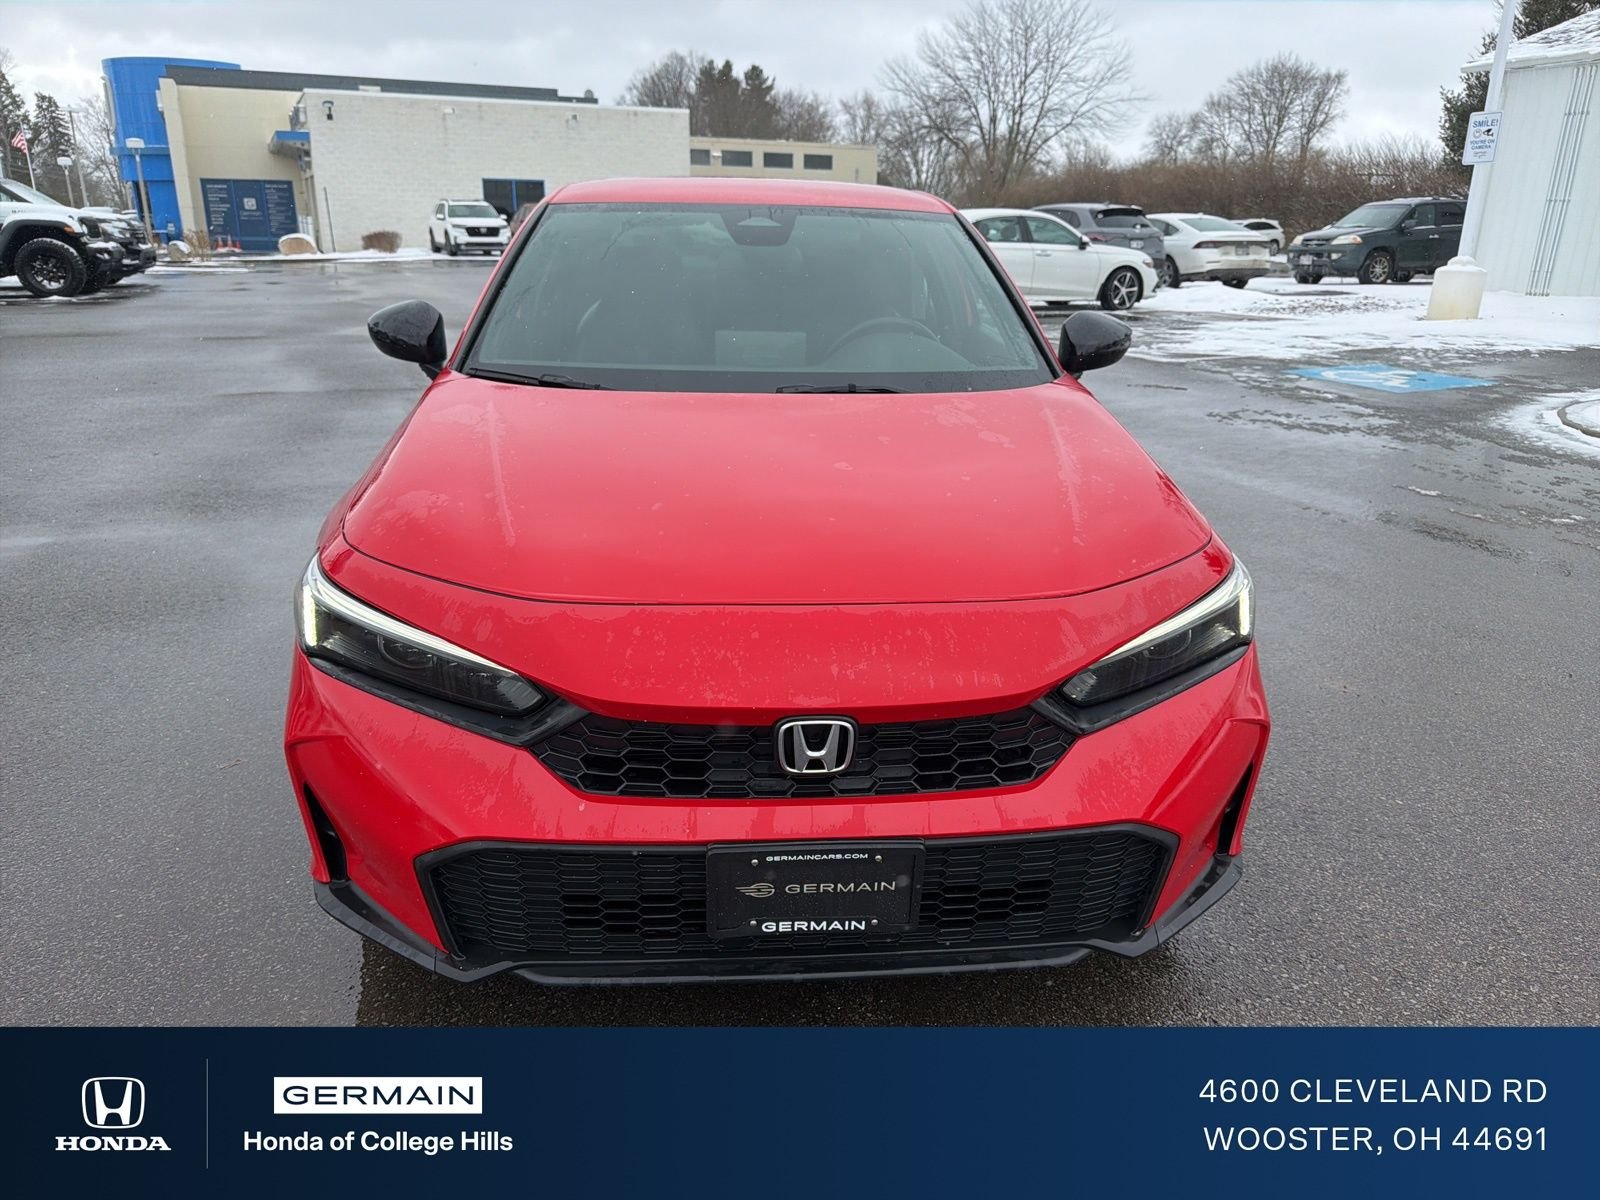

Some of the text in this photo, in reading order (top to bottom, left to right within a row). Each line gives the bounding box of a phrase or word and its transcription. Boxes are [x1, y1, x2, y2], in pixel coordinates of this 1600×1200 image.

[1472, 118, 1499, 128] SMILE!
[766, 853, 868, 862] GERMAINCARS.COM
[785, 881, 896, 894] GERMAIN
[761, 920, 866, 932] GERMAIN
